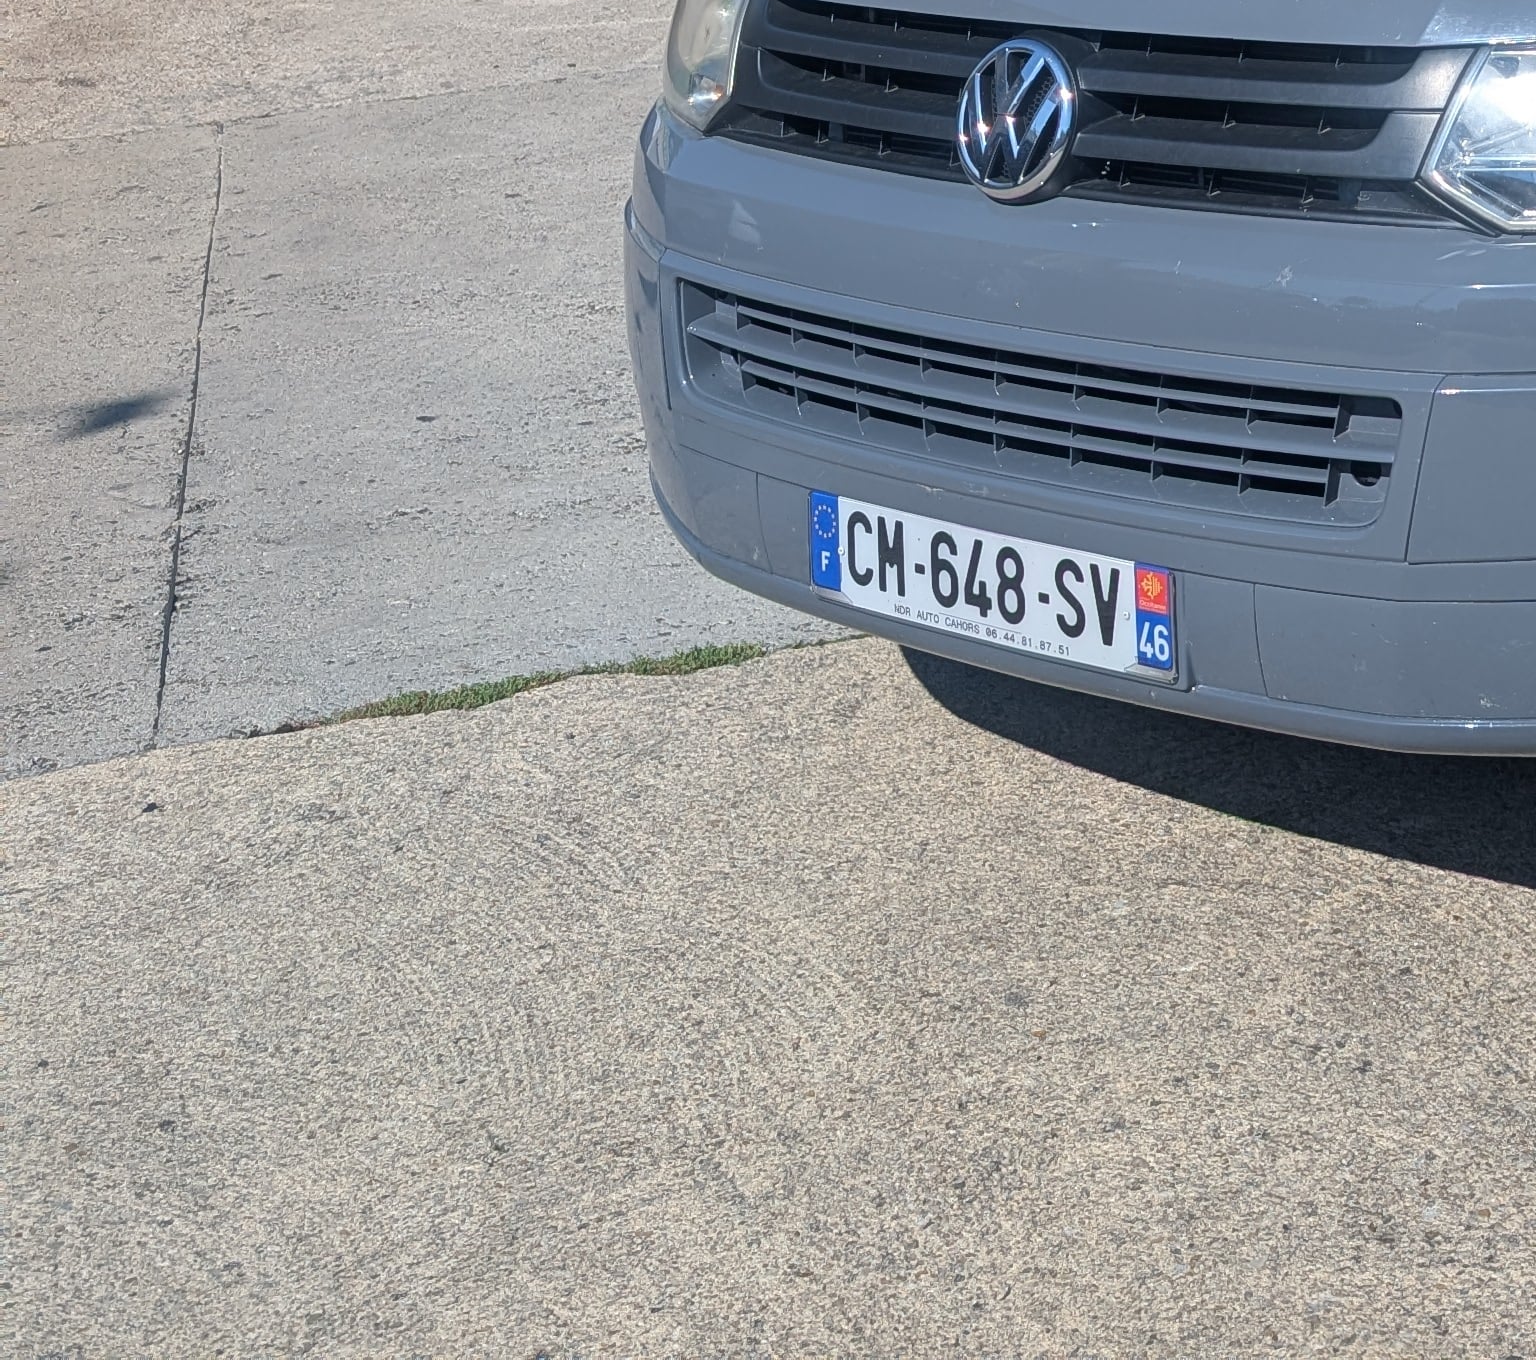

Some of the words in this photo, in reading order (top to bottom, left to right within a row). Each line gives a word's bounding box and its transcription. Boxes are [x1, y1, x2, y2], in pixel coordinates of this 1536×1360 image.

[821, 550, 831, 572] F
[847, 510, 1120, 647] CM-648-SV
[916, 610, 940, 624] AUTO
[944, 617, 980, 634] CAHORS
[985, 626, 1070, 656] 06.44.81.87.51
[1139, 621, 1169, 662] 46
